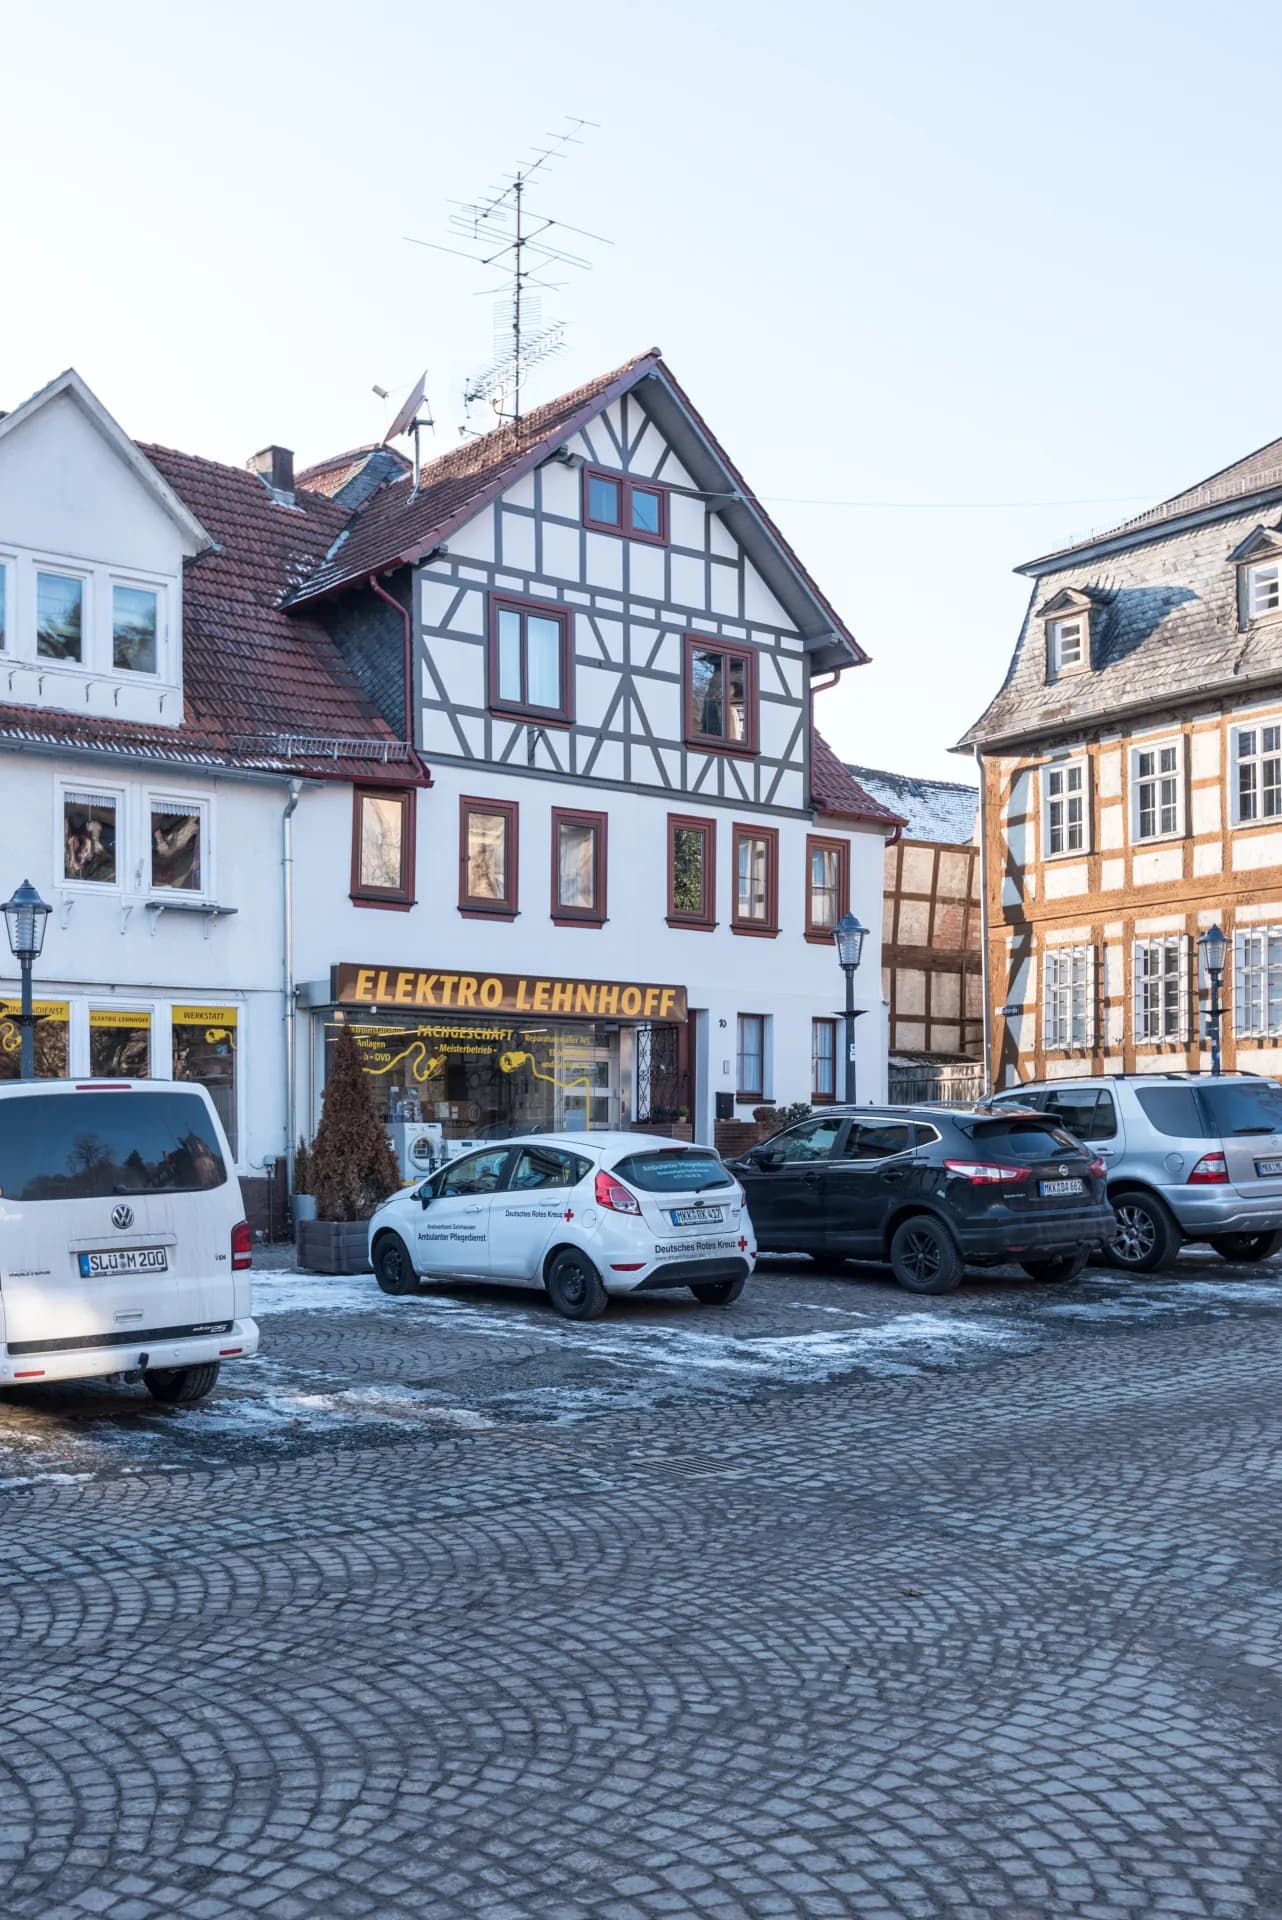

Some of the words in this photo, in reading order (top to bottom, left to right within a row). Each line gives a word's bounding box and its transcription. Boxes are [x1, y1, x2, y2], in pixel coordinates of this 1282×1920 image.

[355, 969, 503, 1008] ELEKTRO
[516, 980, 676, 1017] LEHNHOFF
[183, 1011, 224, 1020] WERKSTATT
[417, 1024, 514, 1040] FACHGESCHÄFT
[547, 1210, 564, 1218] Kreuz
[677, 1211, 692, 1222] MKK
[696, 1210, 707, 1220] RK
[708, 1208, 720, 1219] 417
[418, 1233, 449, 1241] Ambulanter
[450, 1233, 486, 1243] Pflegedienst
[655, 1243, 695, 1253] Deutsches
[696, 1241, 716, 1250] Rotes
[717, 1239, 736, 1248] Kreuz
[91, 1255, 117, 1270] SLÜ
[127, 1253, 136, 1267] M
[139, 1251, 164, 1267] 200
